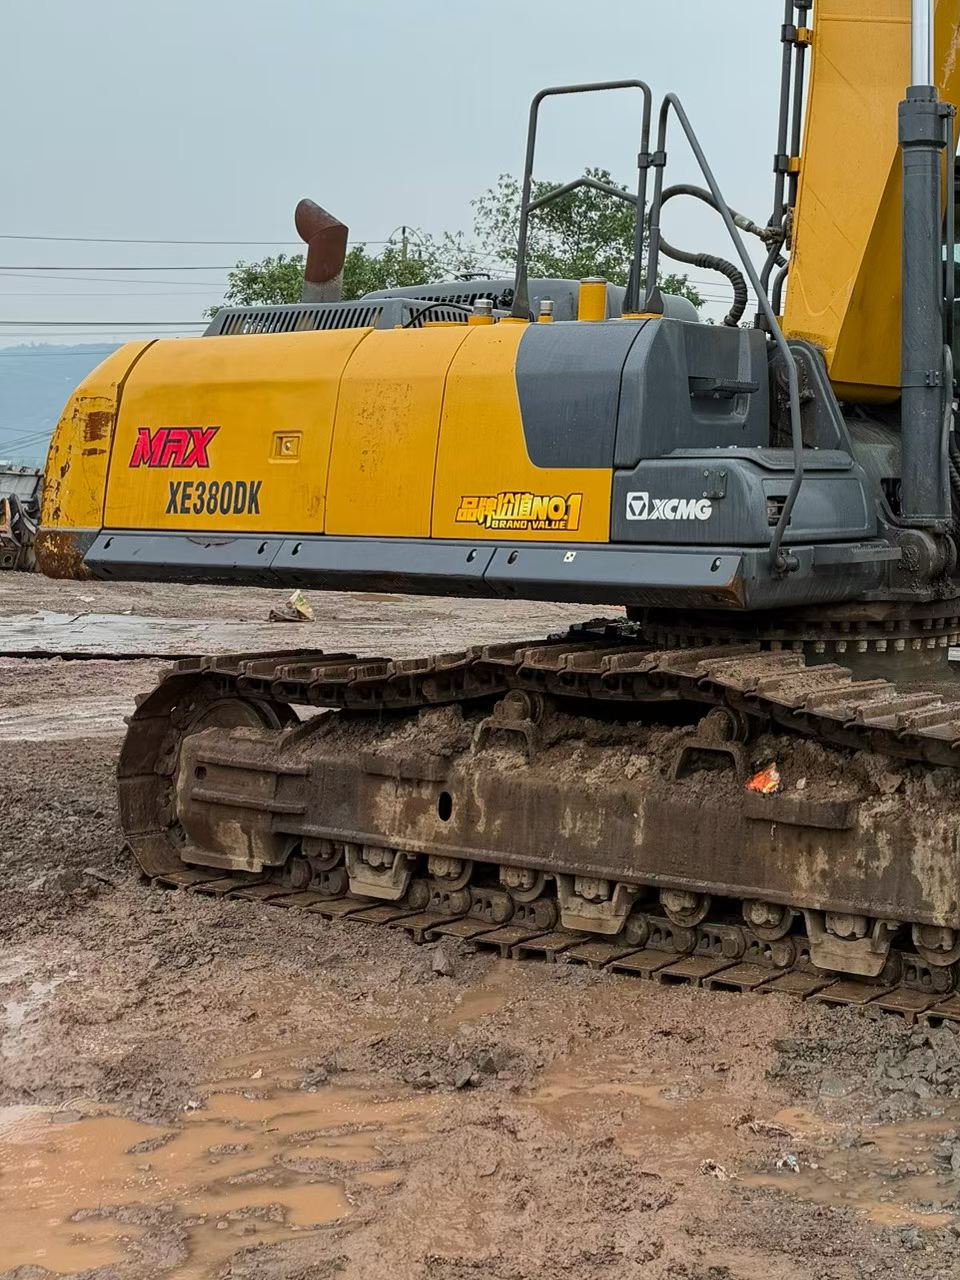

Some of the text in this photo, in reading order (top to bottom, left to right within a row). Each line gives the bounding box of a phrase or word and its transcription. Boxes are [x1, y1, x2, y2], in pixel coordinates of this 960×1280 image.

[128, 426, 221, 468] MAX
[165, 480, 263, 515] XE380DK
[648, 498, 713, 521] XCMG
[491, 520, 567, 530] BRAND VALUE
